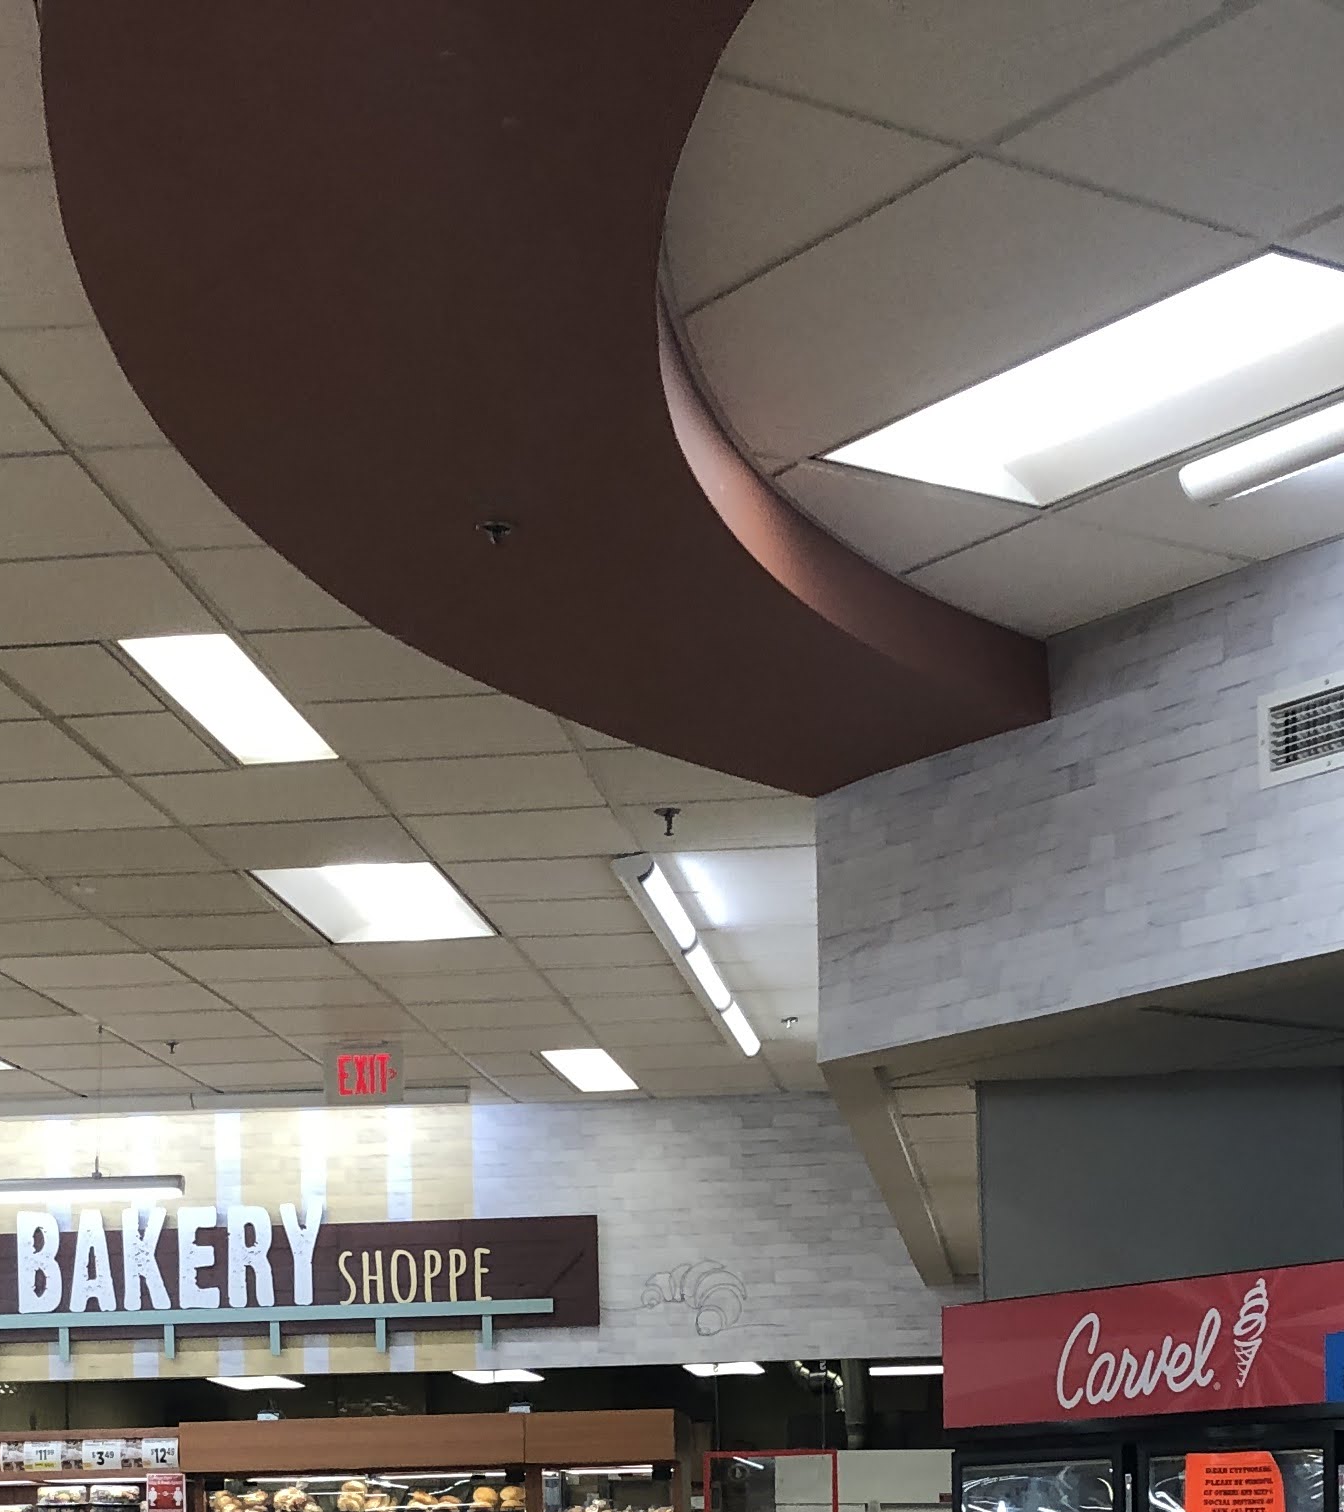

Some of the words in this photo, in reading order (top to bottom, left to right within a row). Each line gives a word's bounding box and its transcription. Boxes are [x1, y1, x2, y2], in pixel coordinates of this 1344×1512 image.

[337, 1053, 392, 1097] EXIT
[16, 1202, 324, 1314] BAKERY
[338, 1247, 494, 1306] SHOPPE
[1056, 1307, 1221, 1410] Carvel
